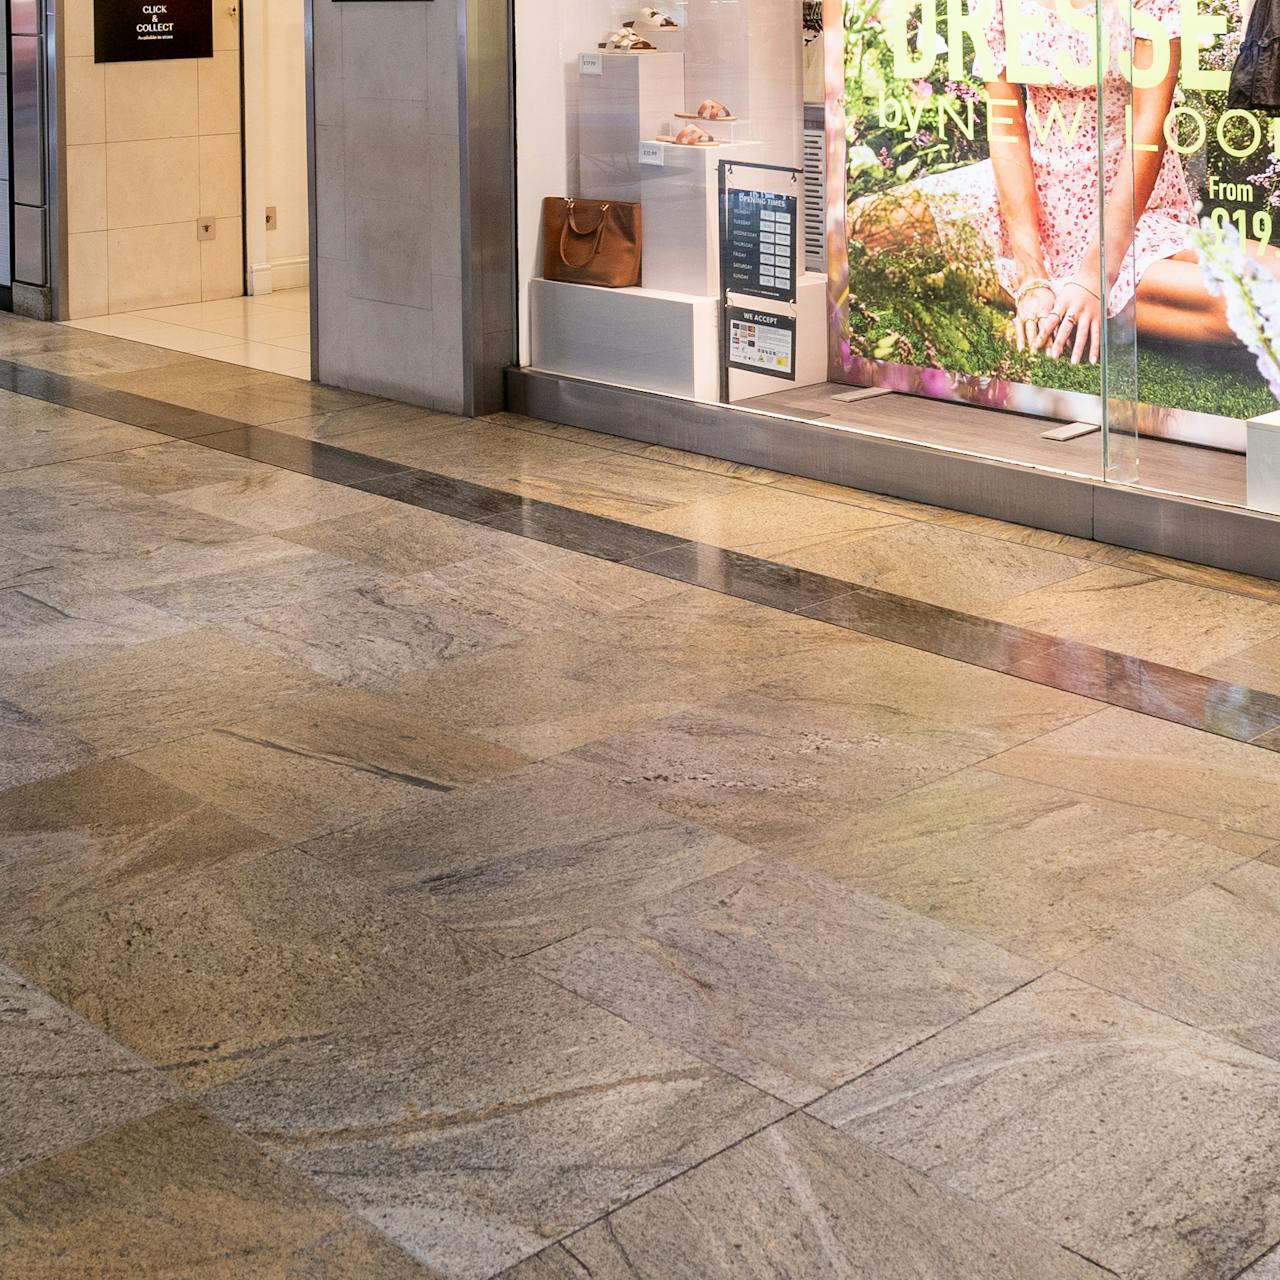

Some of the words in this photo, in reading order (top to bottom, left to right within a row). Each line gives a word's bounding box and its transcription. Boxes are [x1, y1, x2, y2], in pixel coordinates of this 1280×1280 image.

[142, 5, 167, 14] CLICK
[151, 14, 158, 23] &
[136, 22, 174, 33] COLLECT
[878, 88, 923, 138] by
[937, 96, 1086, 146] NEW
[1209, 176, 1254, 202] From
[738, 195, 766, 205] OPENING
[767, 199, 786, 208] TIMES
[743, 312, 753, 320] WE
[754, 315, 778, 325] ACCEPT
